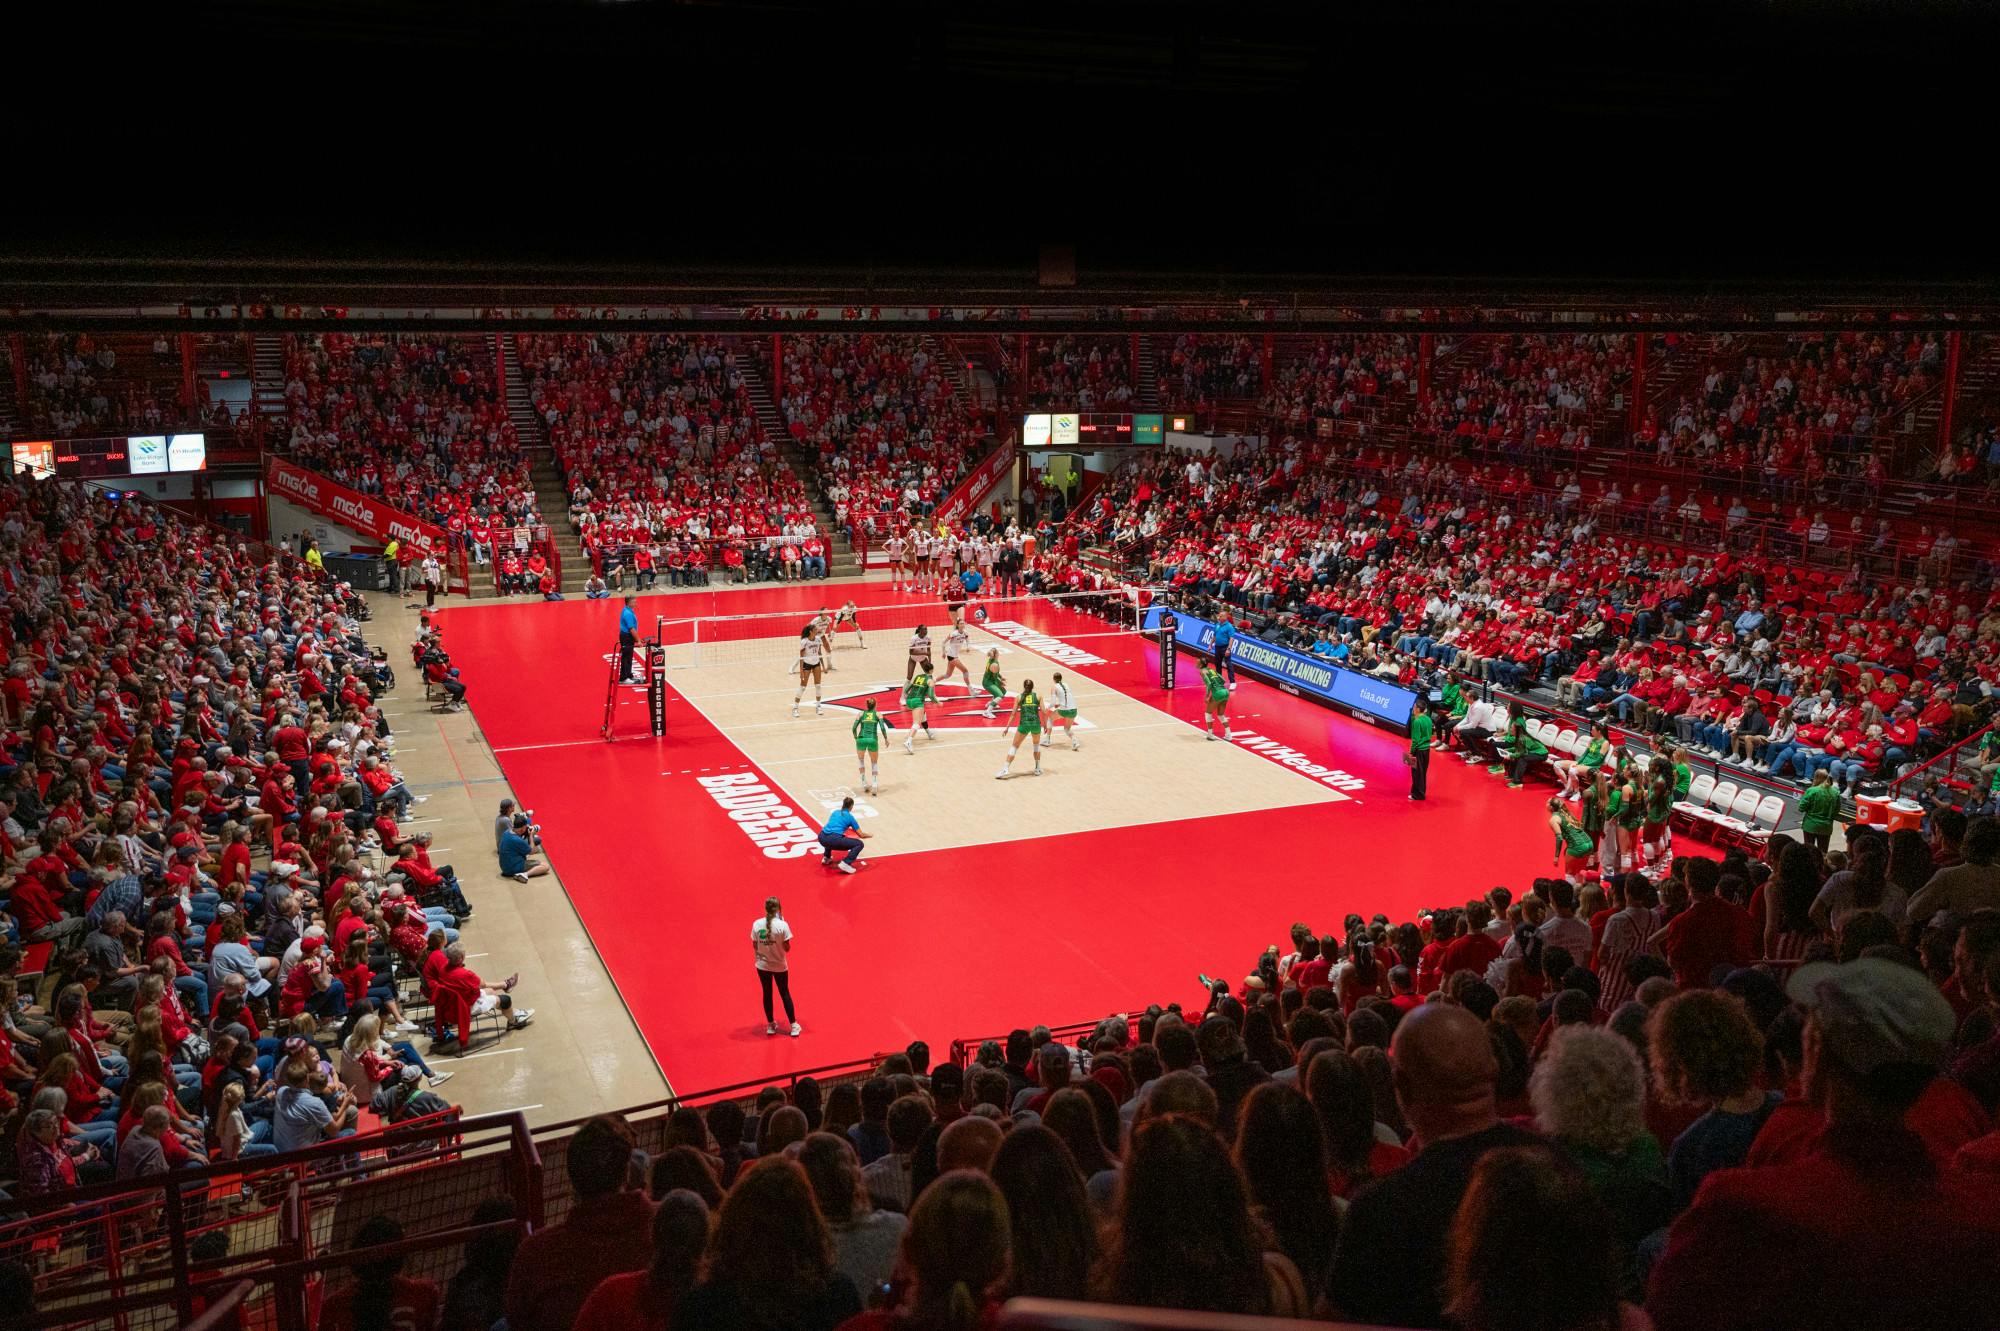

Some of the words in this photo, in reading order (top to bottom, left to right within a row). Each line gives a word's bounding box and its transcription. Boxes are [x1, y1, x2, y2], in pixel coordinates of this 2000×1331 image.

[979, 621, 1108, 665] WISCONSIN
[1237, 642, 1288, 672] RETIREMENT
[1286, 659, 1331, 687] PLANNING
[654, 673, 663, 736] WISCONSIN
[1360, 688, 1390, 708] tiaa.org
[696, 772, 825, 859] BADGERS
[1857, 805, 1869, 819] G
